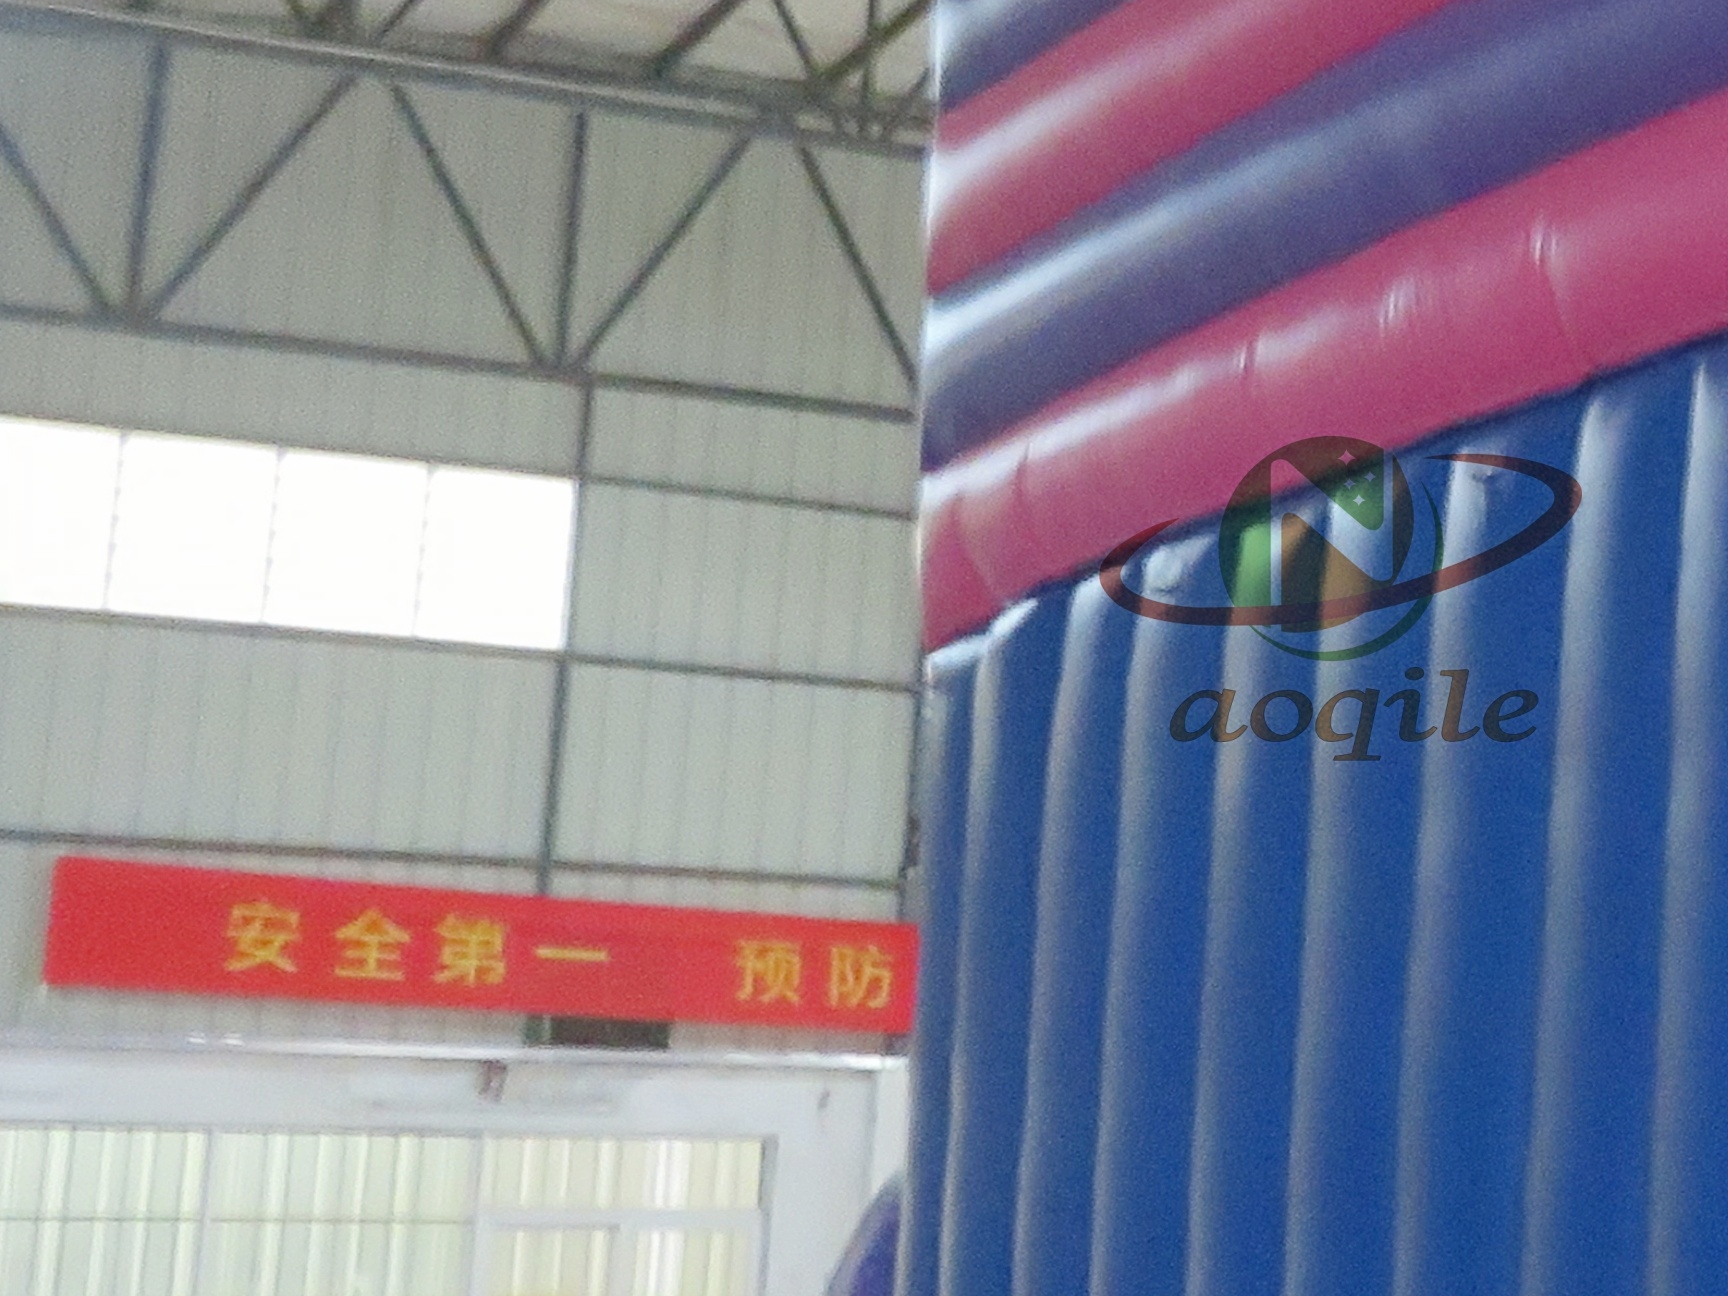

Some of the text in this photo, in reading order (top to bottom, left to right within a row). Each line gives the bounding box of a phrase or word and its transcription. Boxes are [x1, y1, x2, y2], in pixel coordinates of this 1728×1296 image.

[224, 898, 894, 1010] 安全第一 预防
